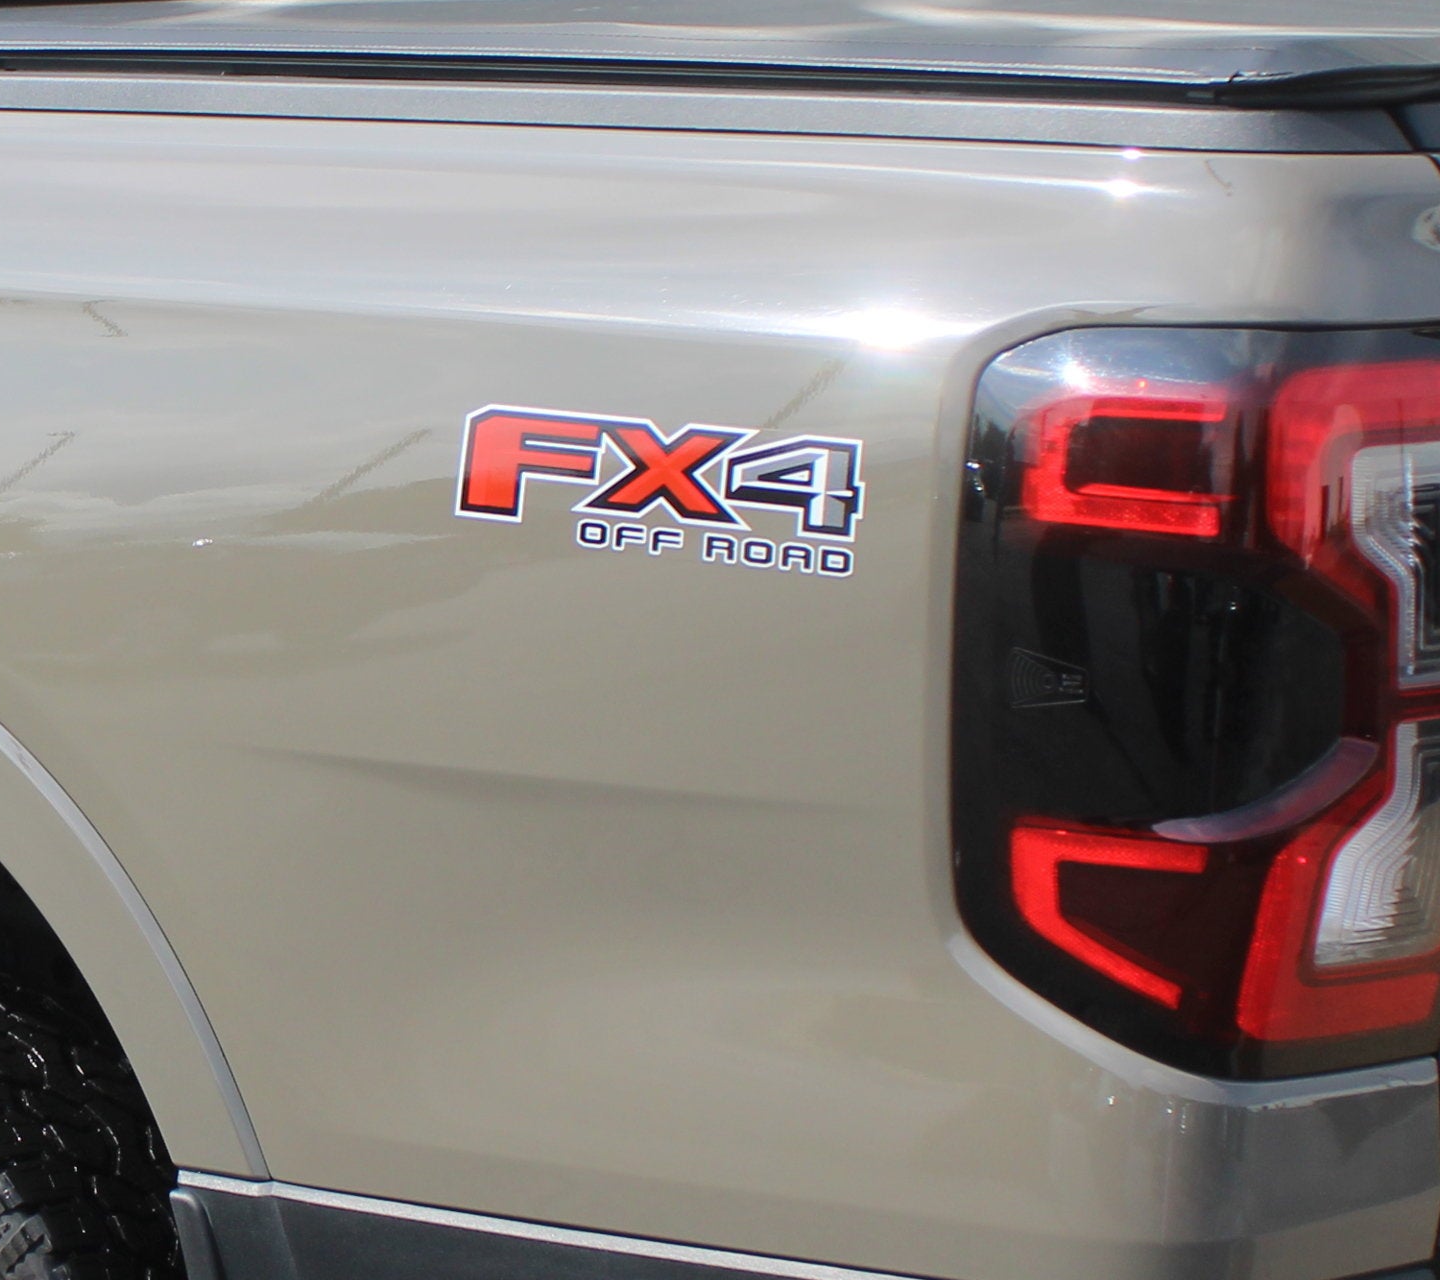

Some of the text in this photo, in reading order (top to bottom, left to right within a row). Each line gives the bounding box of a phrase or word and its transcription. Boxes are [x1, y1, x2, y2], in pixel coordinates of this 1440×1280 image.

[455, 404, 865, 542] FX4
[577, 519, 855, 577] OFF ROAD
